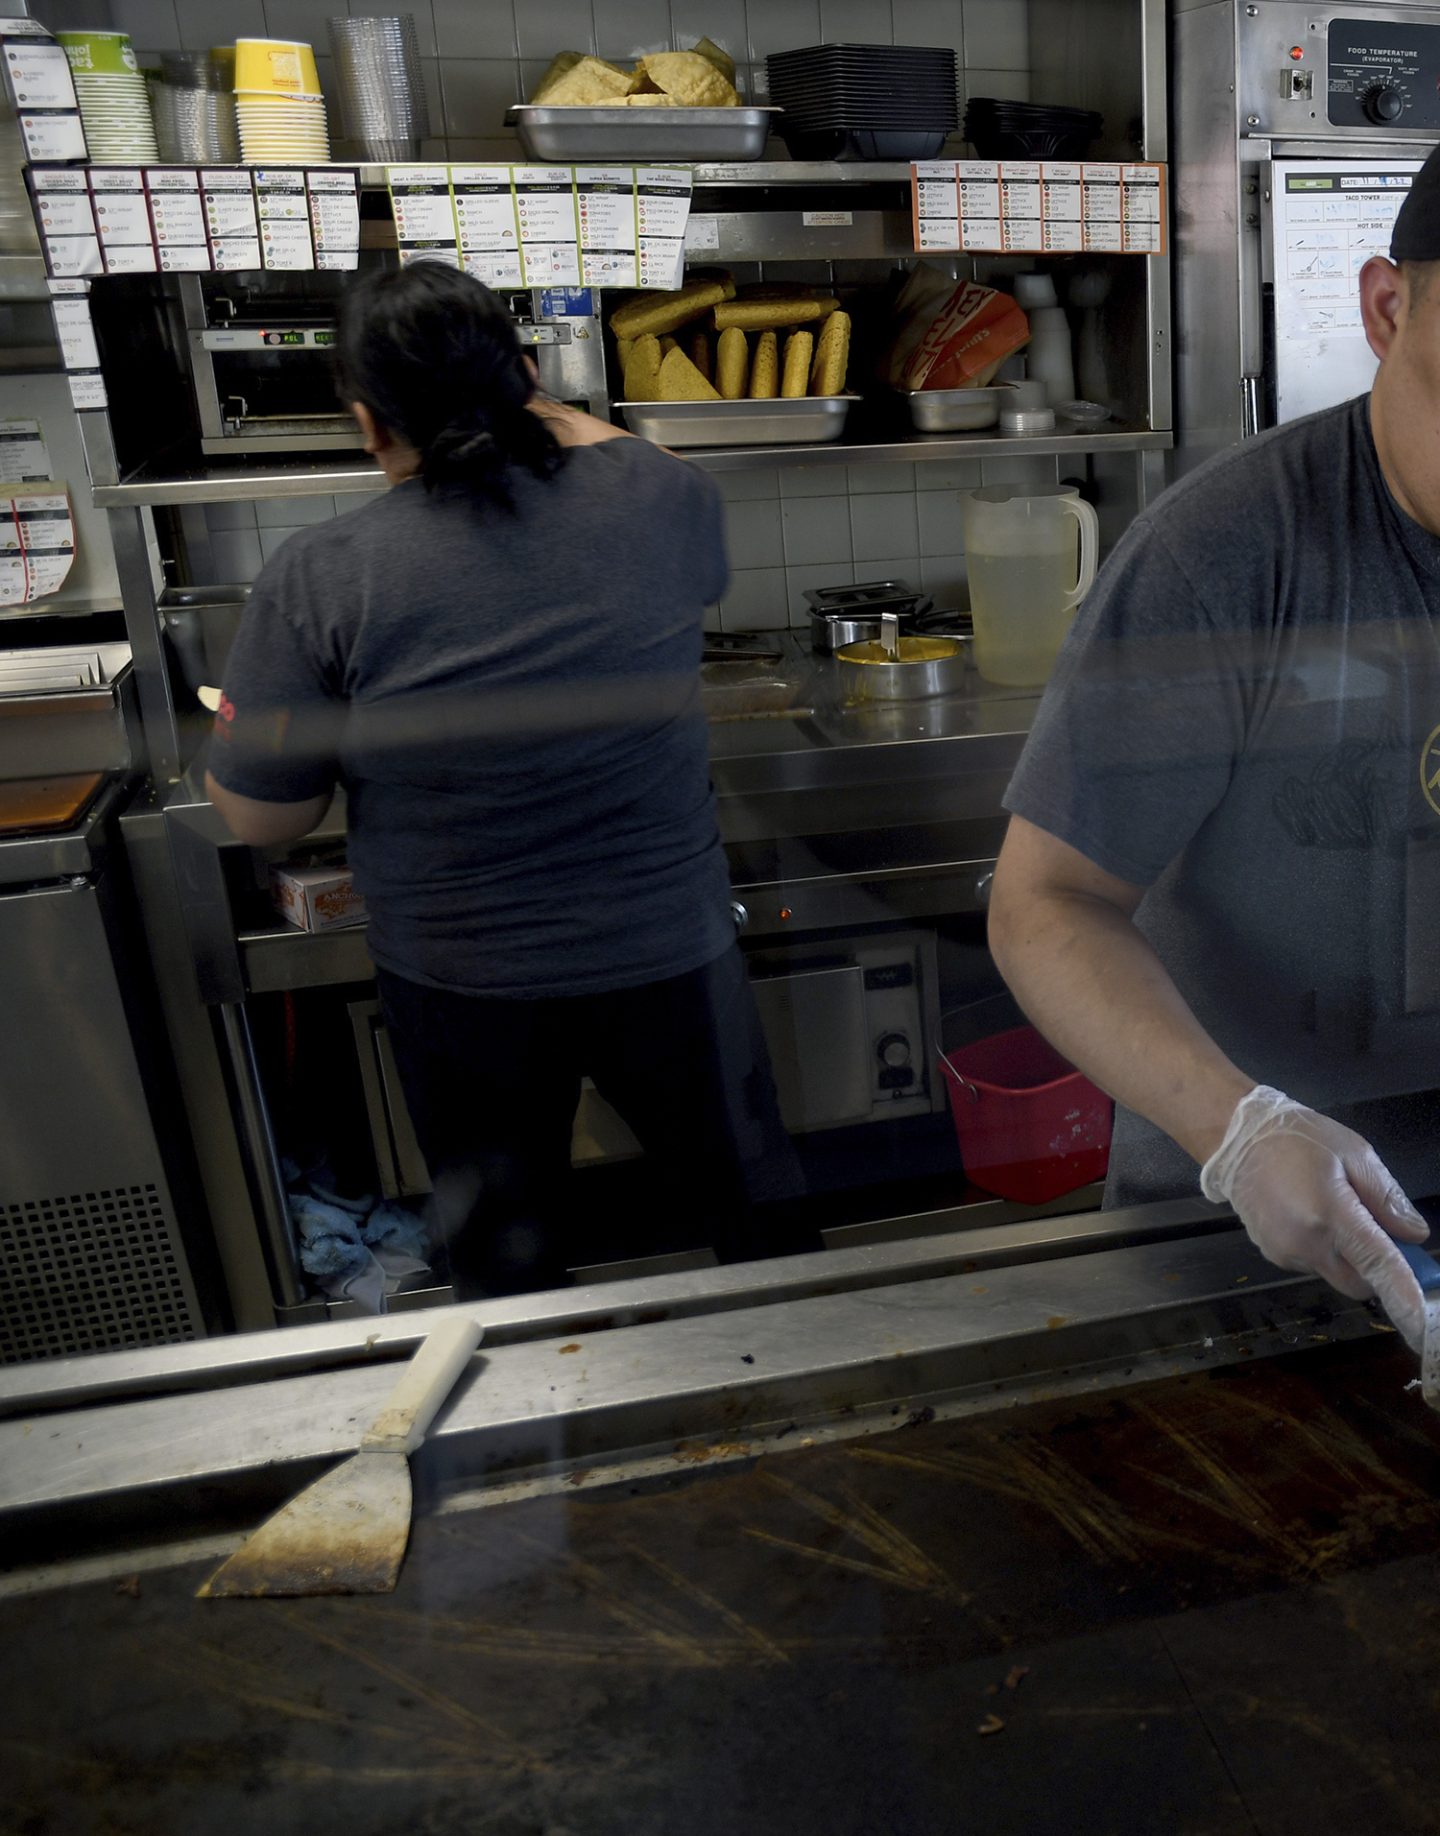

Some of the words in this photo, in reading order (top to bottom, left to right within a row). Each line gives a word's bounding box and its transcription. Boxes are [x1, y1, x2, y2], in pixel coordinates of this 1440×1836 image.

[1347, 47, 1368, 55] FOOD
[1369, 48, 1418, 58] TEMPERATURE
[71, 57, 95, 69] tac
[1361, 56, 1404, 65] (EVAPORATOR)
